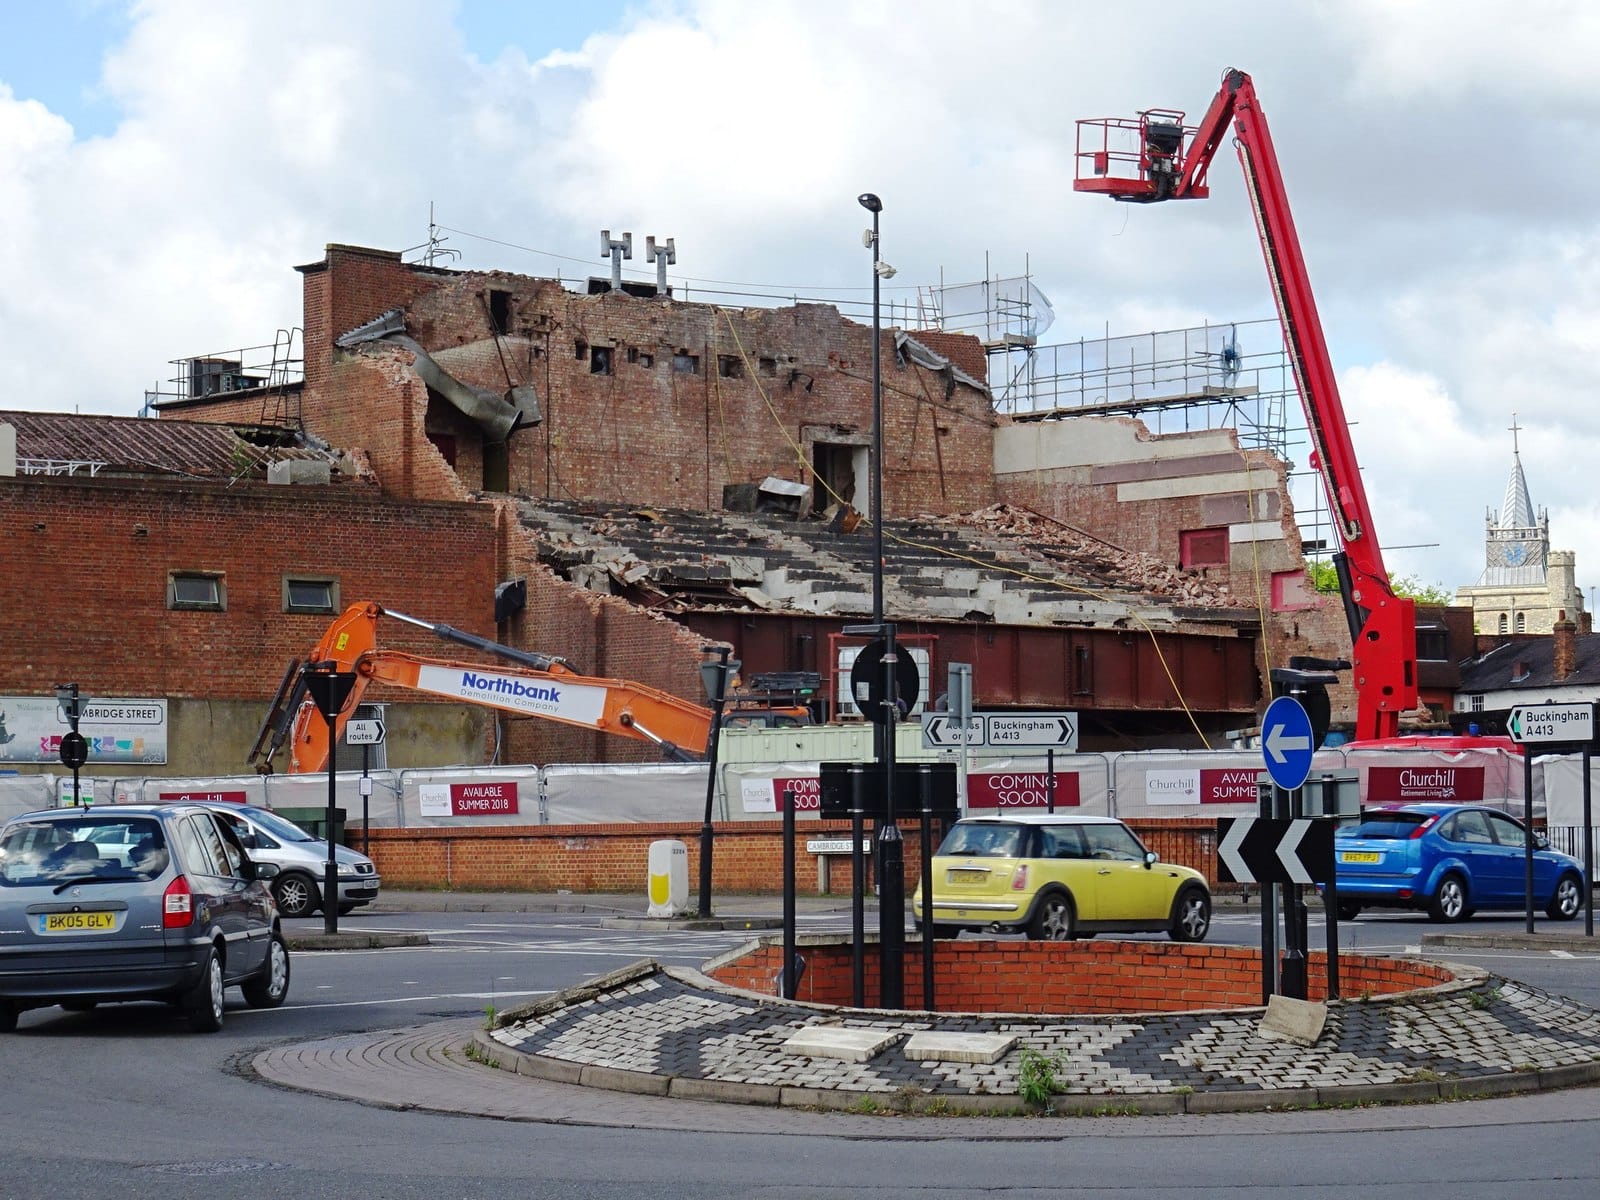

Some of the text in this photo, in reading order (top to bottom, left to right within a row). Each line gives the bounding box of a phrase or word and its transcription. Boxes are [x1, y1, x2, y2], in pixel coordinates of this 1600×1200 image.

[462, 672, 561, 702] Northbank
[460, 689, 559, 712] Demolition Company
[82, 709, 157, 719] MBRIDGE STREET
[1526, 711, 1589, 723] Buckingham
[946, 721, 980, 730] Acss
[994, 721, 1054, 732] Buckingham
[952, 733, 973, 741] oy
[988, 776, 1058, 789] COMING
[1221, 773, 1256, 784] AVAIL
[1400, 769, 1455, 786] Churchill
[786, 780, 820, 793] COMIN
[1150, 778, 1194, 789] Churchill
[463, 786, 502, 797] AVAILABLE
[998, 790, 1050, 804] SOON
[1212, 786, 1257, 798] SUMME
[1427, 789, 1442, 798] Living
[458, 799, 509, 810] SUMMER 2018
[794, 794, 820, 808] SOO
[808, 842, 845, 850] CAMBRIDGE
[50, 914, 112, 928] BK05 GLY
